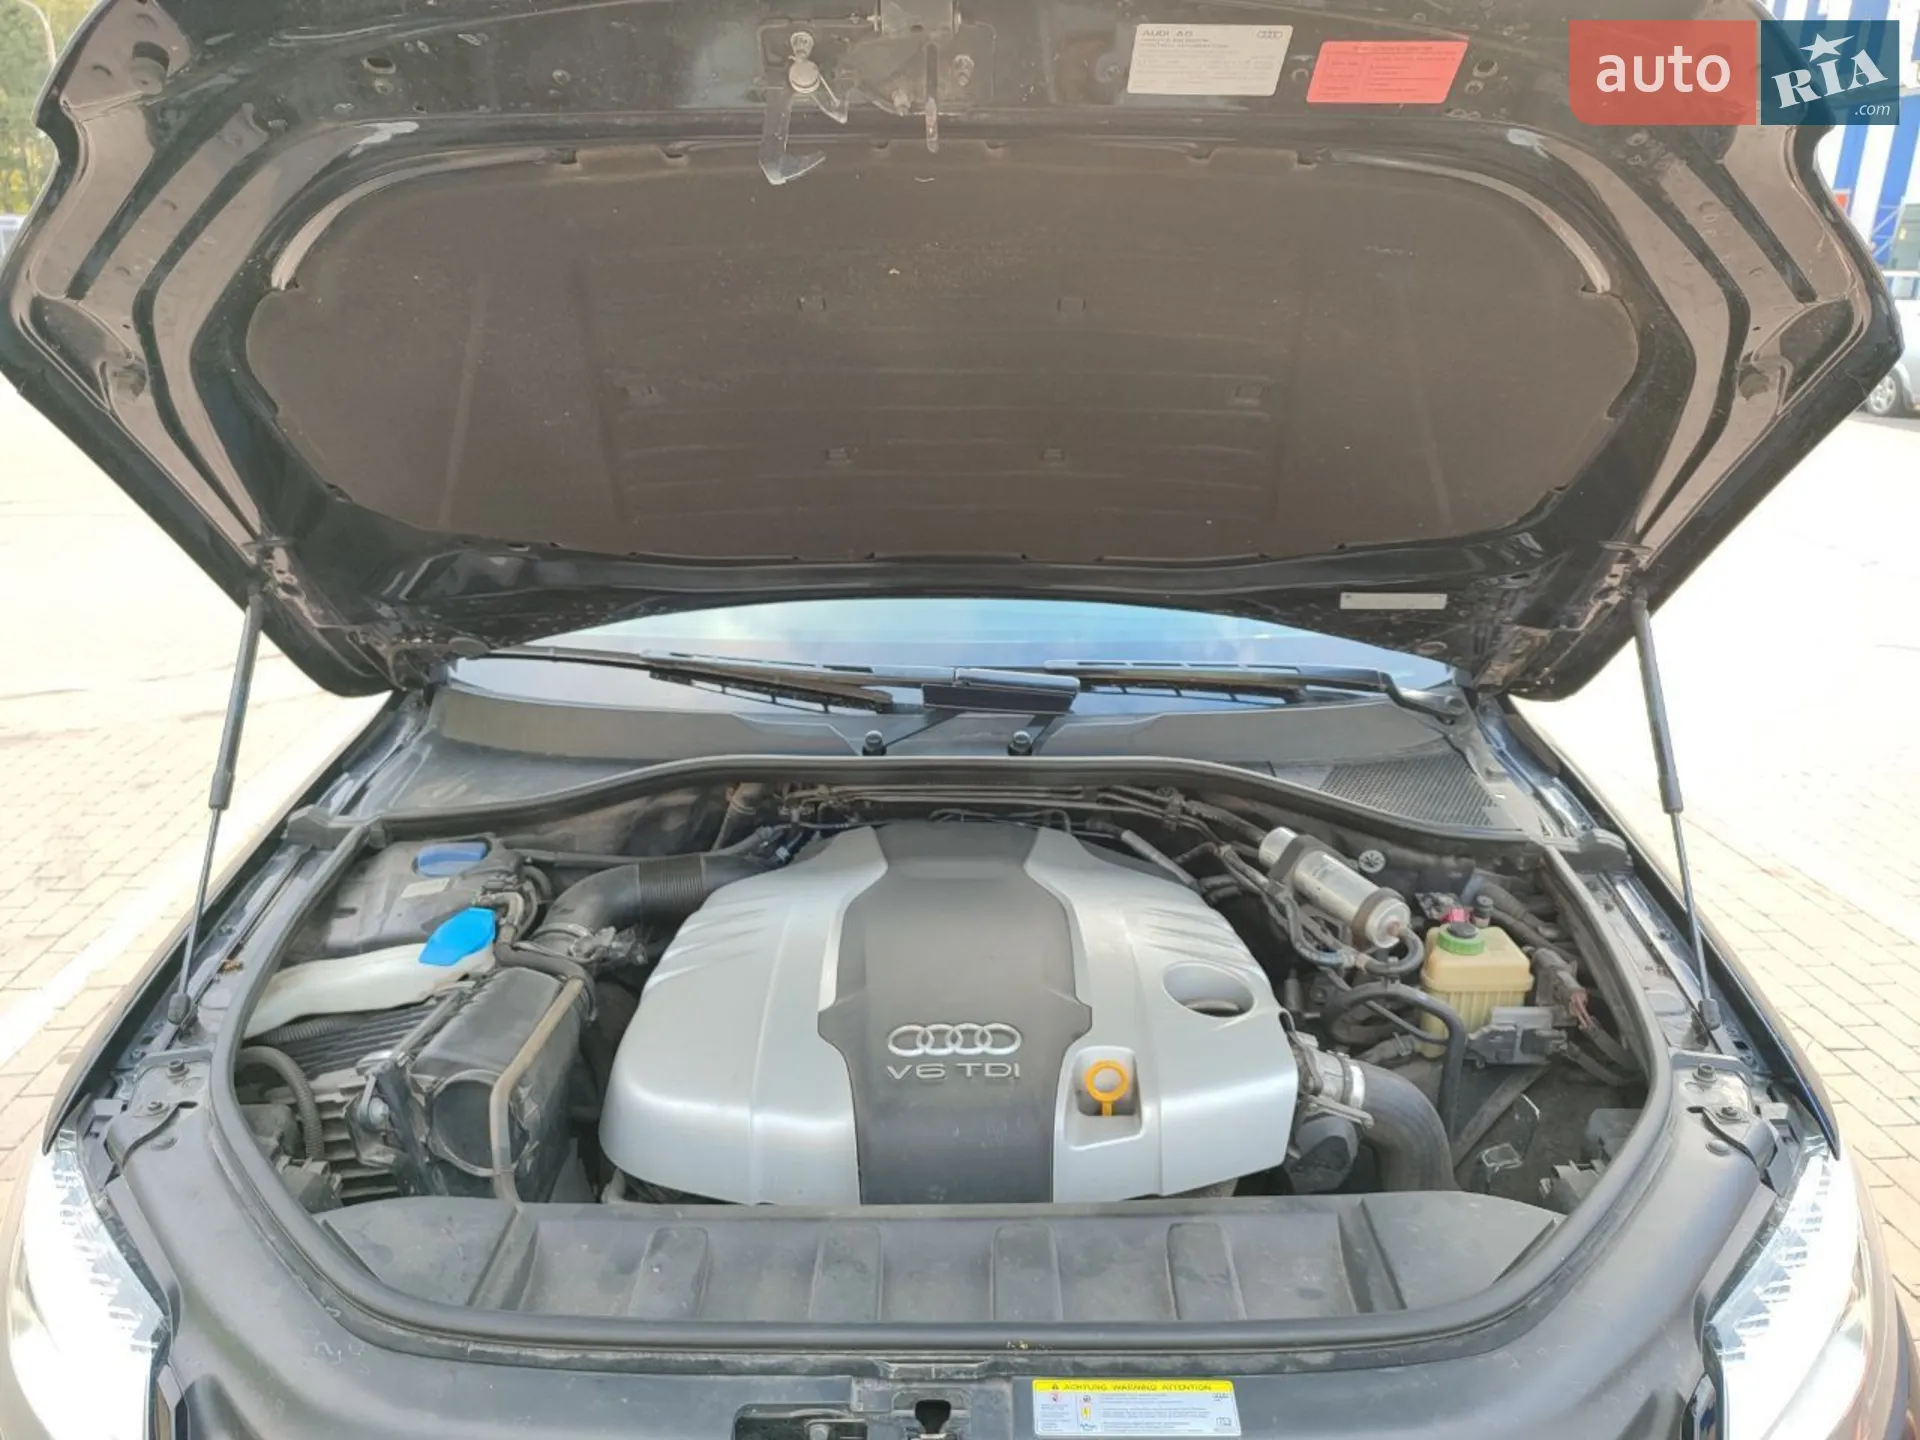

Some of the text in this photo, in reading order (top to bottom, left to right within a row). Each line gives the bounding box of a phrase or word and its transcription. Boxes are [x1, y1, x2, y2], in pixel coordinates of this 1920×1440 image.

[1142, 29, 1170, 37] AUDI
[887, 1063, 1020, 1079] V6 TDI
[1063, 1383, 1108, 1391] ACHTUNG
